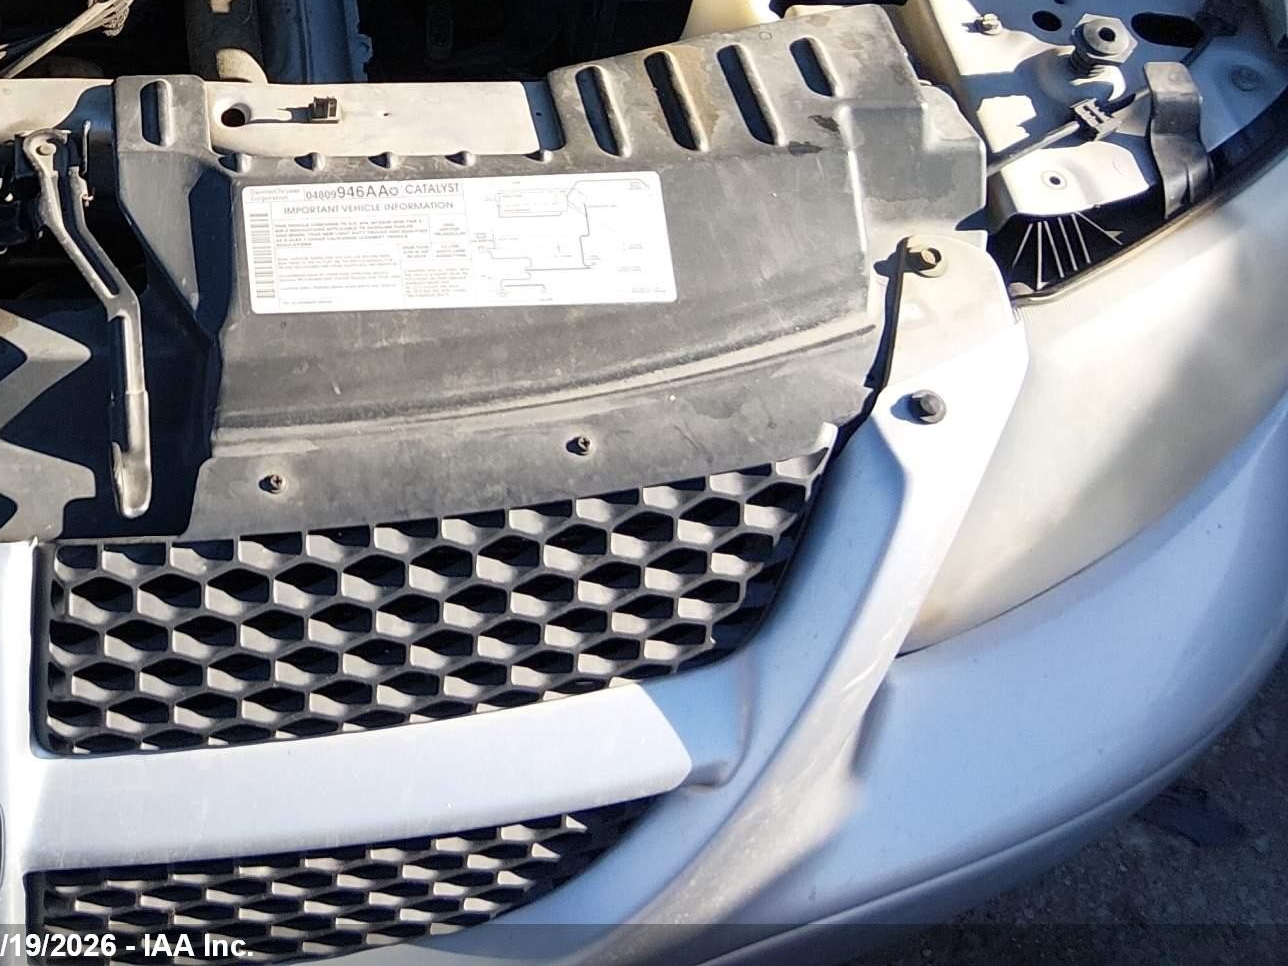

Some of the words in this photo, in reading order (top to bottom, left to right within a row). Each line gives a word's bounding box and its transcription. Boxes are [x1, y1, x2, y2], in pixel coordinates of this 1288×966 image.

[404, 182, 460, 195] CATALYST
[284, 204, 339, 215] IMPORTANT
[341, 203, 381, 213] VEHICLE
[384, 201, 454, 212] INFORMATION
